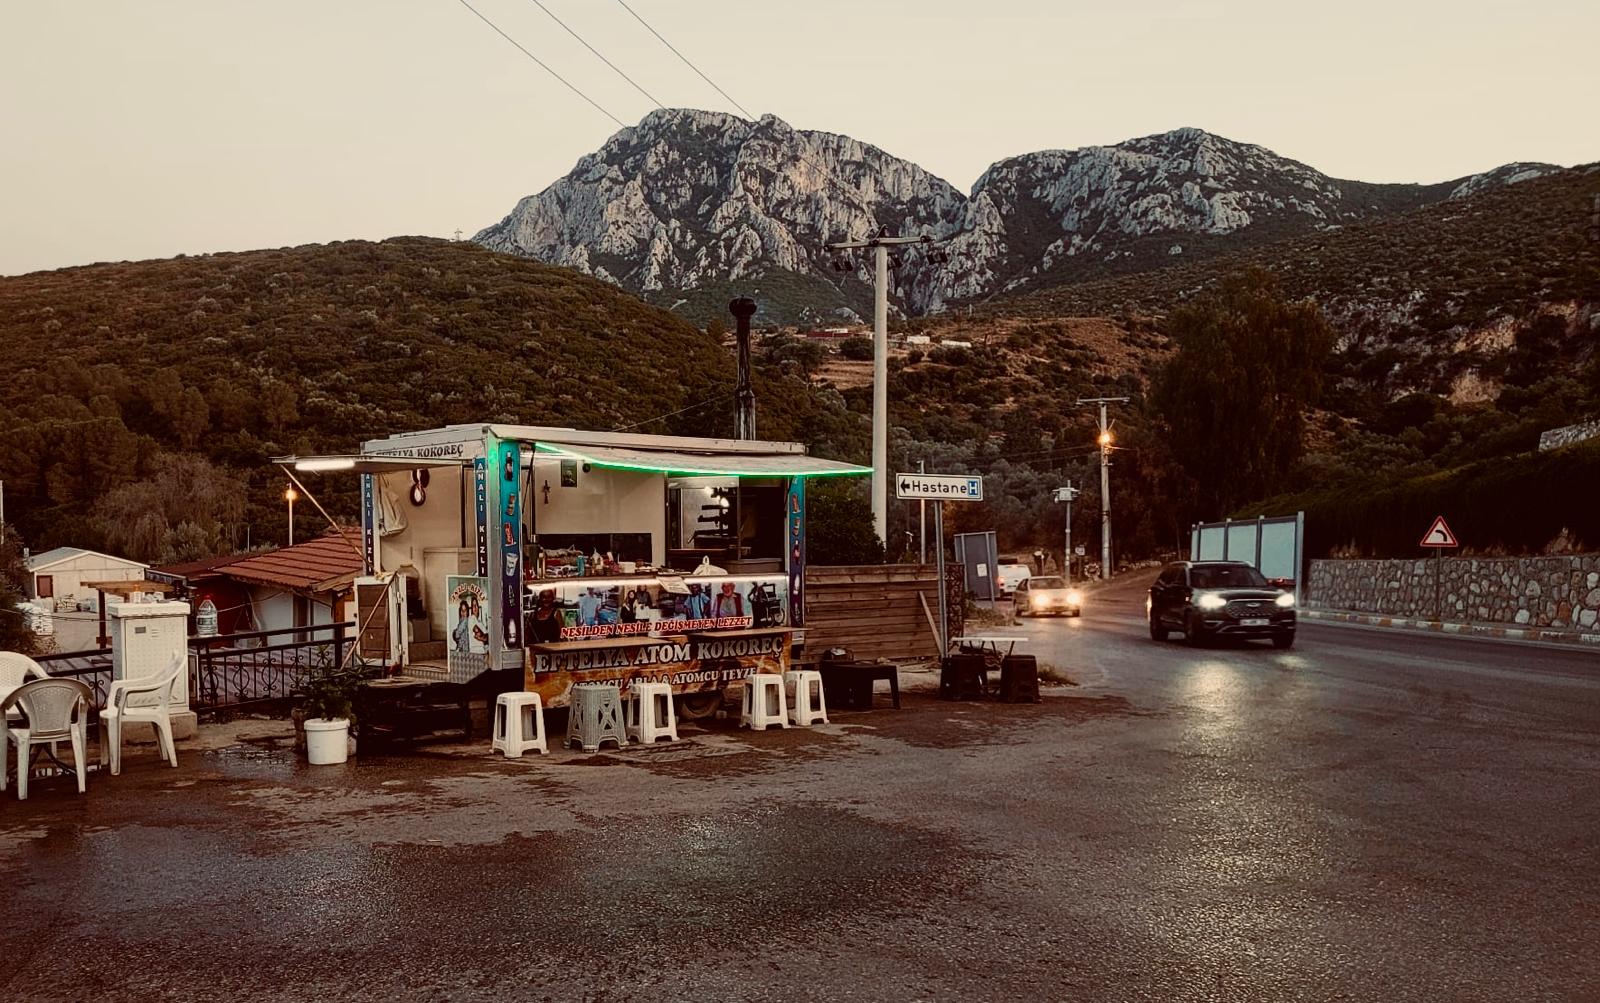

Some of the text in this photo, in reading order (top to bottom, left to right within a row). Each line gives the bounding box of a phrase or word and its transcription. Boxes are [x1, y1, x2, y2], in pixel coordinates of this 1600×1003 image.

[417, 444, 464, 457] KOKOREÇ
[912, 480, 967, 494] Hastane
[717, 616, 752, 628] LEZZET
[535, 637, 783, 673] EFTELYA ATOM KOKOREÇ
[672, 671, 719, 684] ATOMCU
[722, 667, 756, 680] TEYZE
